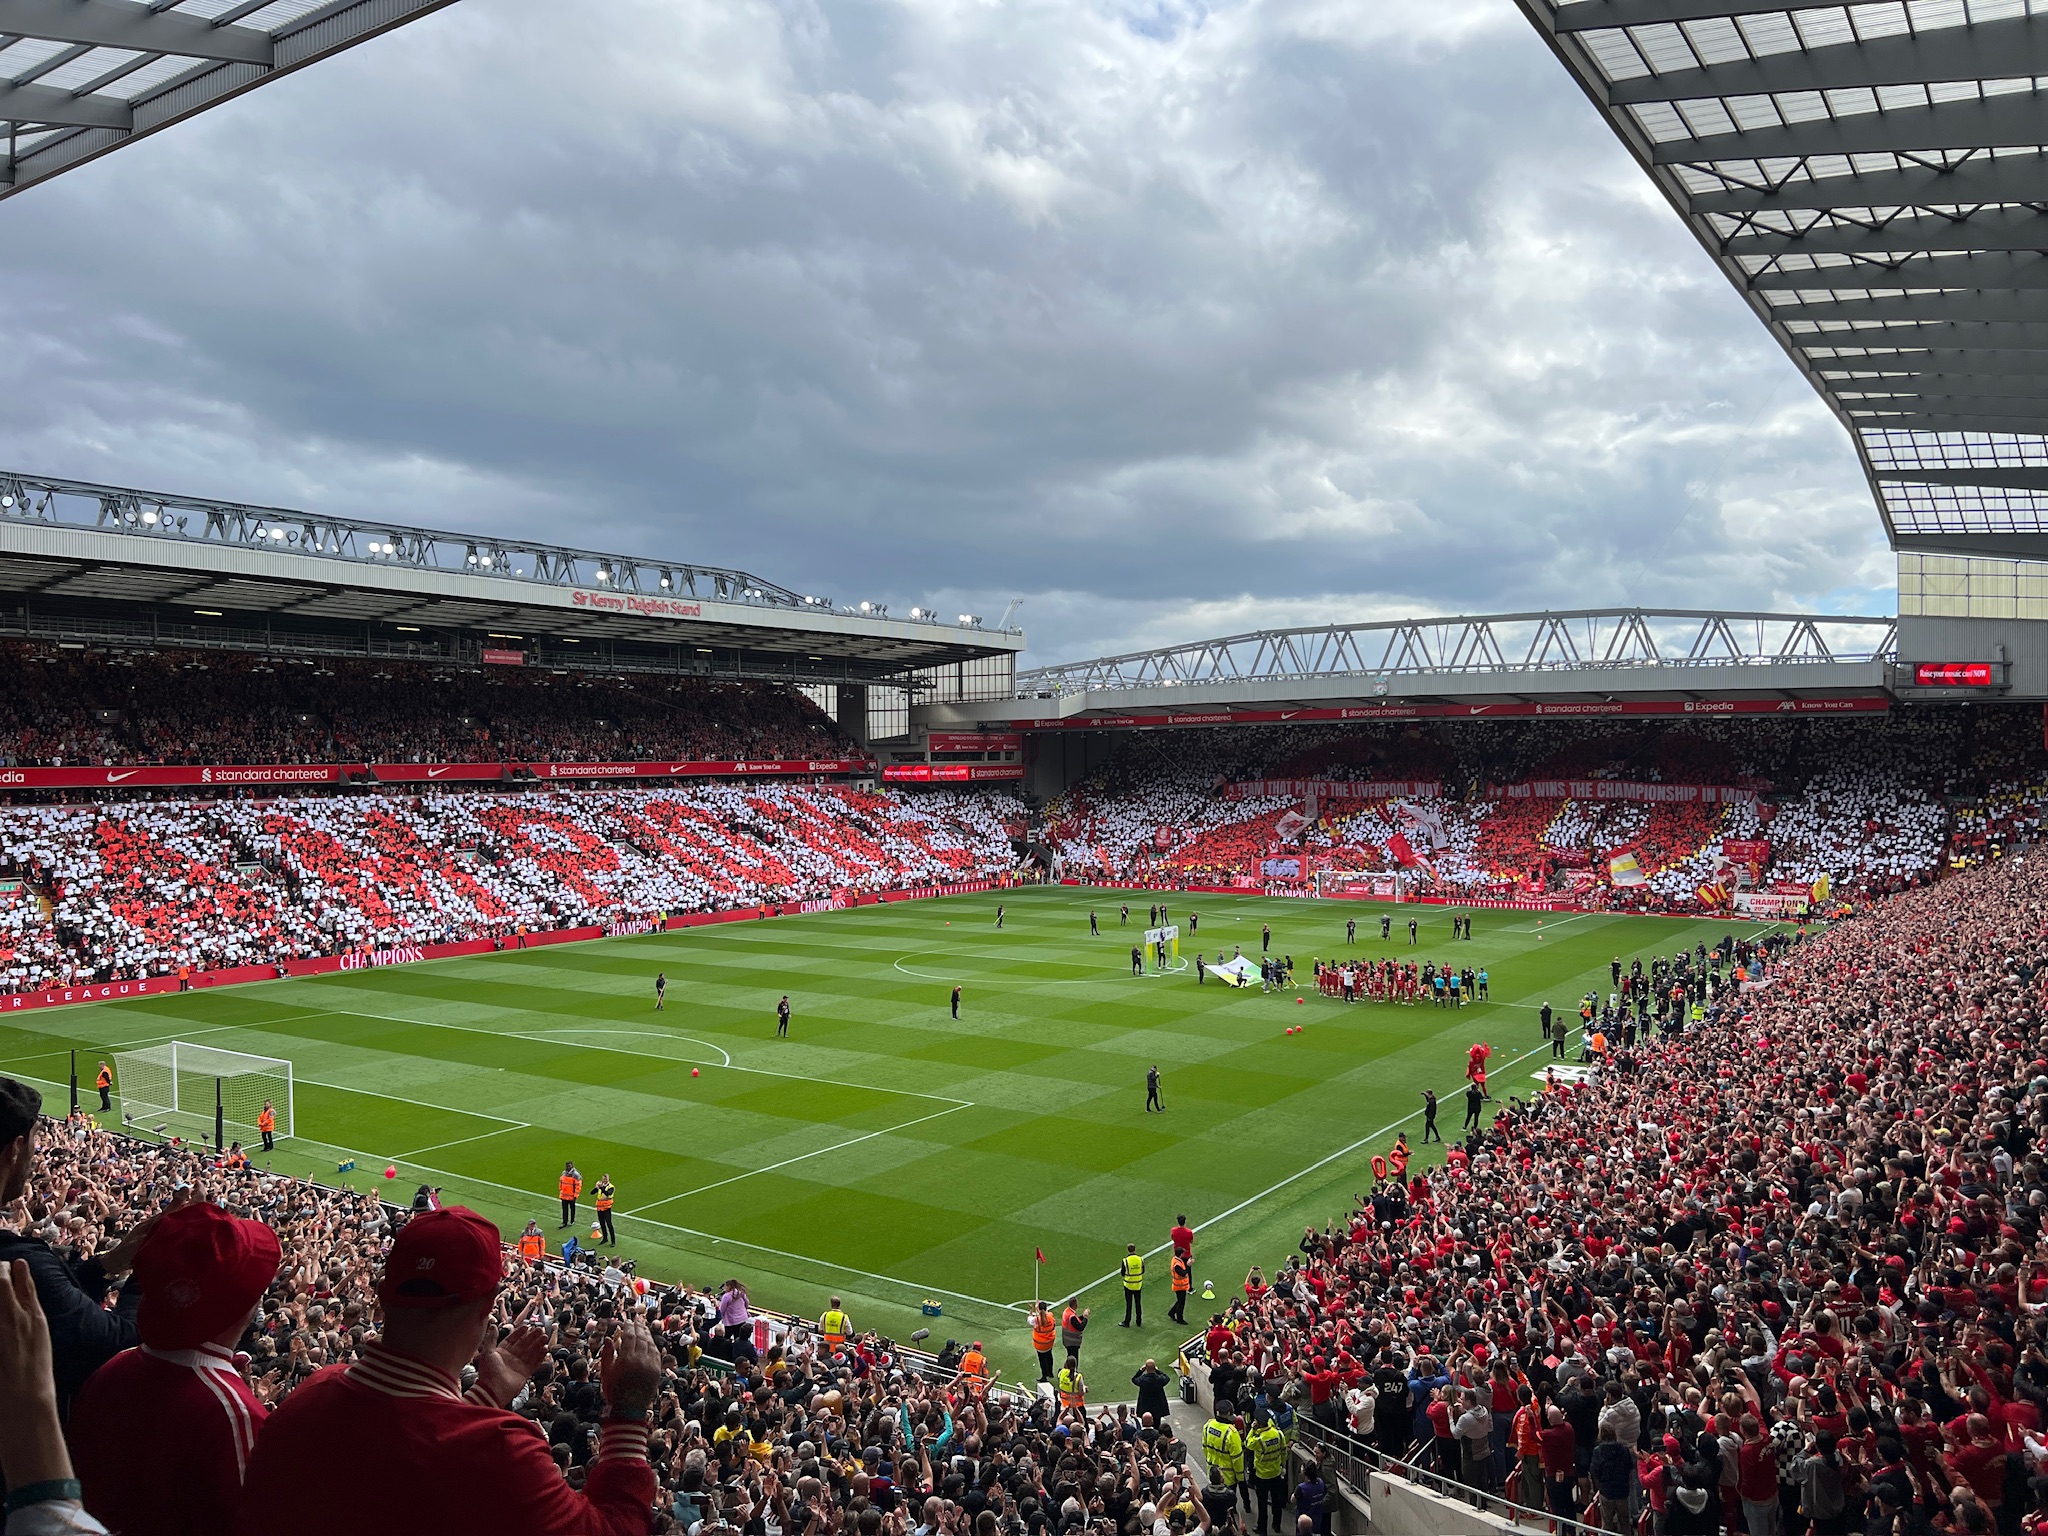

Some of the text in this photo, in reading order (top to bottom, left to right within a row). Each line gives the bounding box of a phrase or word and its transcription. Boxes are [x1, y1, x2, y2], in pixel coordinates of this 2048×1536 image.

[572, 591, 700, 617] Sir Kenny Dalglish Stand
[1920, 669, 1987, 679] Raise your mosaic card NOW
[1348, 708, 1416, 717] standard chartered
[1544, 704, 1623, 713] standard chartered
[1695, 702, 1734, 712] Expedia
[1776, 701, 1796, 711] AXA
[559, 765, 636, 775] standard chartered
[733, 762, 747, 772] AXA
[815, 762, 838, 771] Expedia
[0, 771, 25, 783] dia
[215, 768, 328, 781] standard chartered
[1237, 781, 1264, 796] TEAM
[1267, 781, 1292, 795] THAT
[1295, 781, 1327, 797] PLAYS
[1329, 782, 1350, 797] THE
[1352, 782, 1409, 798] LIVERPOOL
[1414, 782, 1440, 797] WAY
[1507, 781, 1753, 803] AND WINS THE CHAMPIONSHIP IN MAY
[800, 898, 846, 914] CHAMPIONS
[340, 946, 424, 970] CHAMPIONS
[46, 983, 147, 1003] LEAGUE
[416, 1257, 436, 1270] 20
[1384, 1381, 1404, 1394] 247
